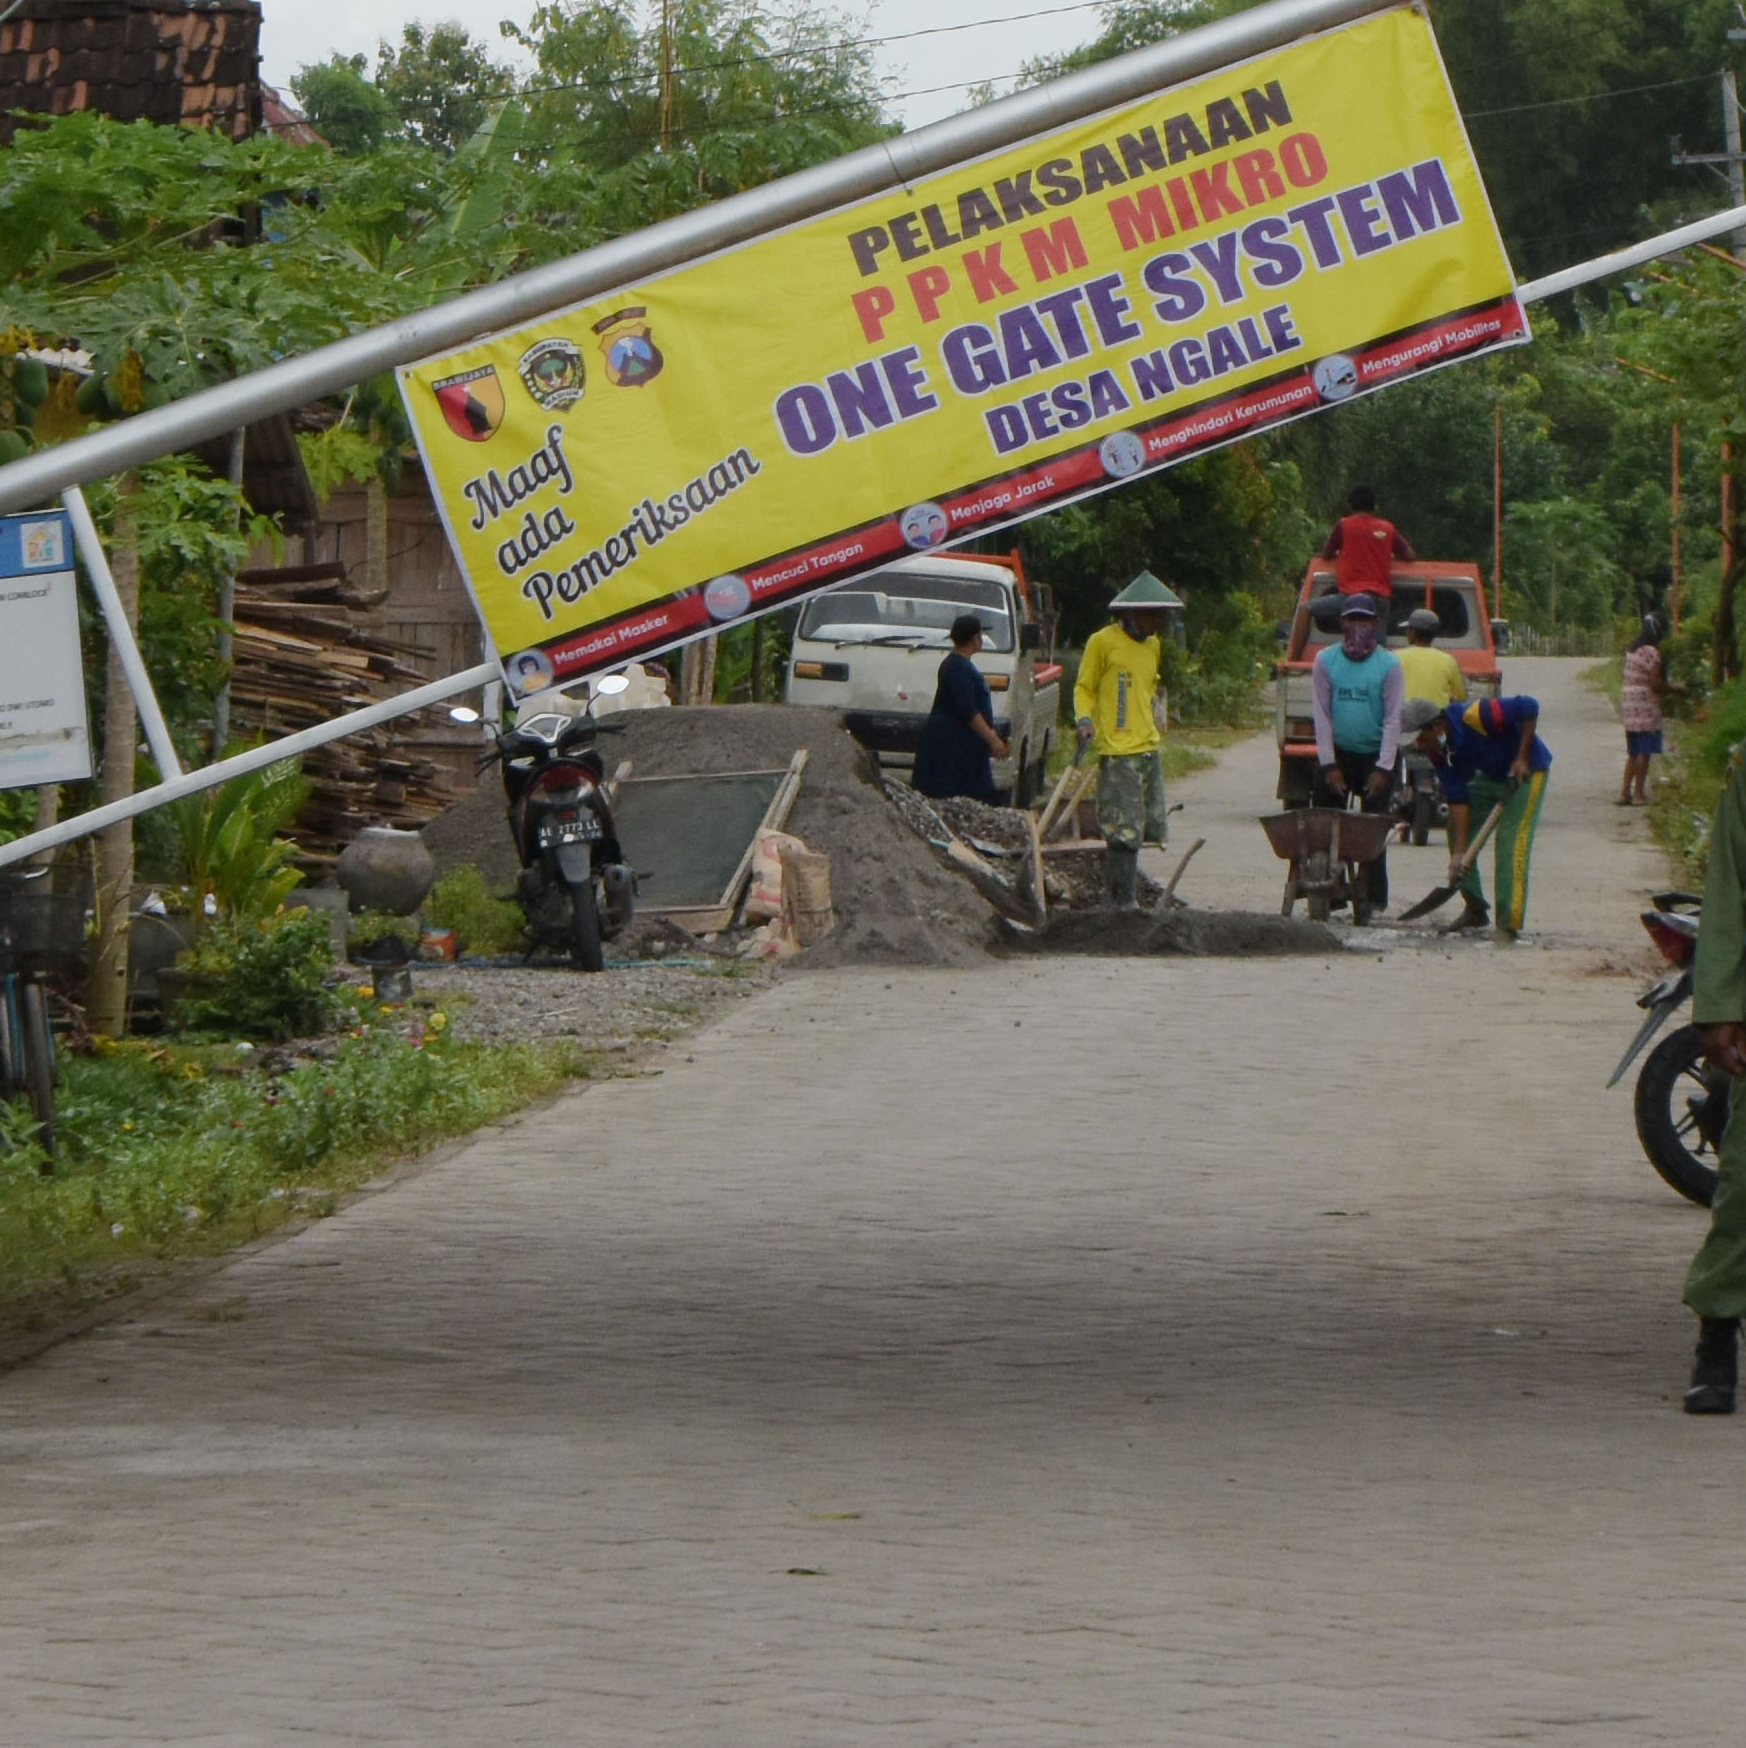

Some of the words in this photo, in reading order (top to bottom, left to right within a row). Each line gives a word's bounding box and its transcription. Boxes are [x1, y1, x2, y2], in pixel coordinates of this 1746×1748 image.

[848, 79, 1293, 278] PELAKSANAAN
[1106, 132, 1329, 252] MIKRO
[773, 343, 941, 457] ONE
[940, 272, 1143, 399] GATE
[1142, 156, 1464, 327] SYSTEM
[433, 365, 495, 391] BRAWIJAYA
[982, 368, 1131, 457] DESA
[1129, 302, 1302, 404] NGALE
[1361, 337, 1445, 376] Mengurangi
[1444, 317, 1502, 345] Mobilitas
[1149, 409, 1234, 453] Menghindari
[1235, 383, 1312, 422] Kerumunan
[464, 423, 574, 531] Maaf
[950, 490, 1013, 525] Menjaga
[1014, 475, 1055, 500] Jarak
[497, 504, 575, 575] ada
[521, 446, 763, 621] Pemeriksaan
[751, 555, 809, 592] Mencuci
[810, 541, 864, 576] Tangan
[554, 631, 618, 666] Memakai
[618, 613, 670, 644] Masker
